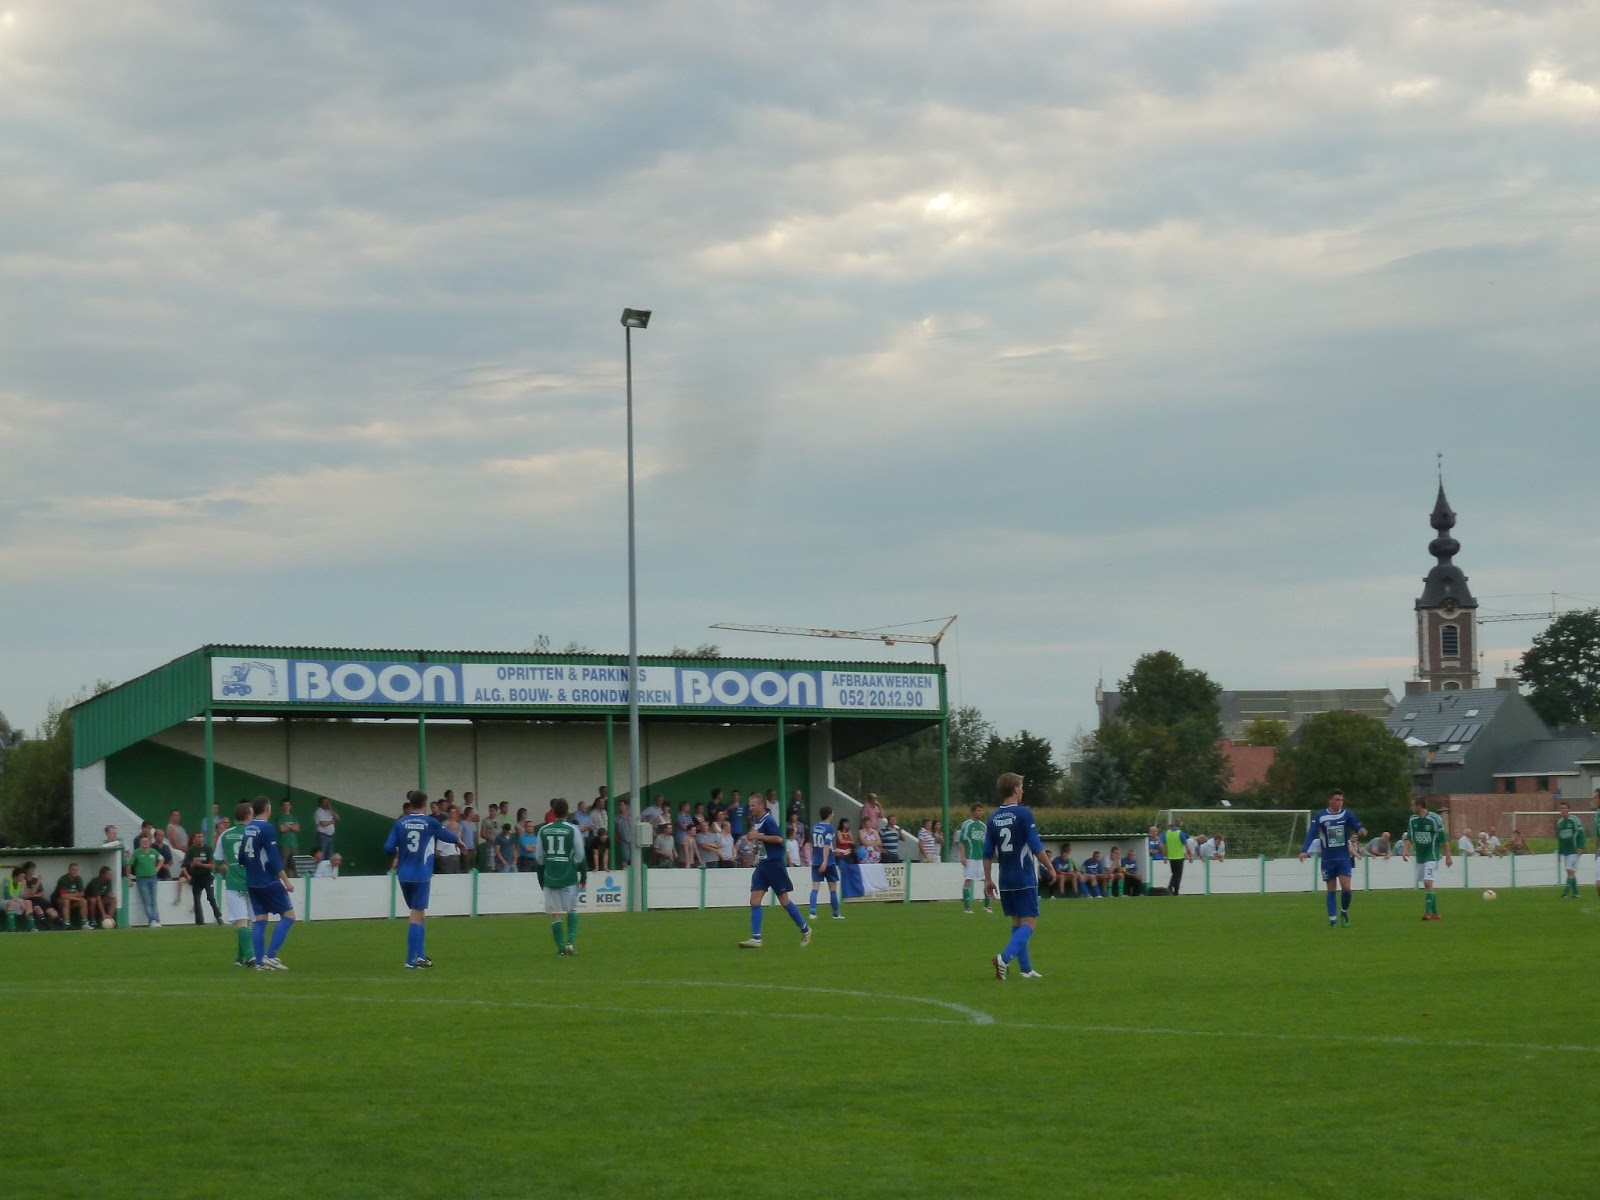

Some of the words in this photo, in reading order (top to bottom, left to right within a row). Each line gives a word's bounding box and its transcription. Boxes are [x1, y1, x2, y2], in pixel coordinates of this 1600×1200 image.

[295, 662, 457, 702] BOON
[496, 666, 564, 681] OPRITTEN
[568, 667, 578, 681] &
[582, 668, 647, 682] PARKINS
[831, 673, 932, 689] AFBRAAKWERKEN
[474, 688, 505, 702] ALG.
[509, 688, 553, 703] BOUW-
[557, 688, 567, 702] &
[572, 689, 672, 703] GRONDWRKEN
[681, 670, 817, 706] BOON
[839, 689, 923, 707] 052/20.12.90
[244, 836, 255, 858] 4
[406, 830, 421, 853] 3
[546, 835, 566, 855] 11
[812, 833, 824, 848] 10
[999, 827, 1014, 852] 2
[884, 866, 904, 877] SPORT
[596, 893, 622, 903] KBC
